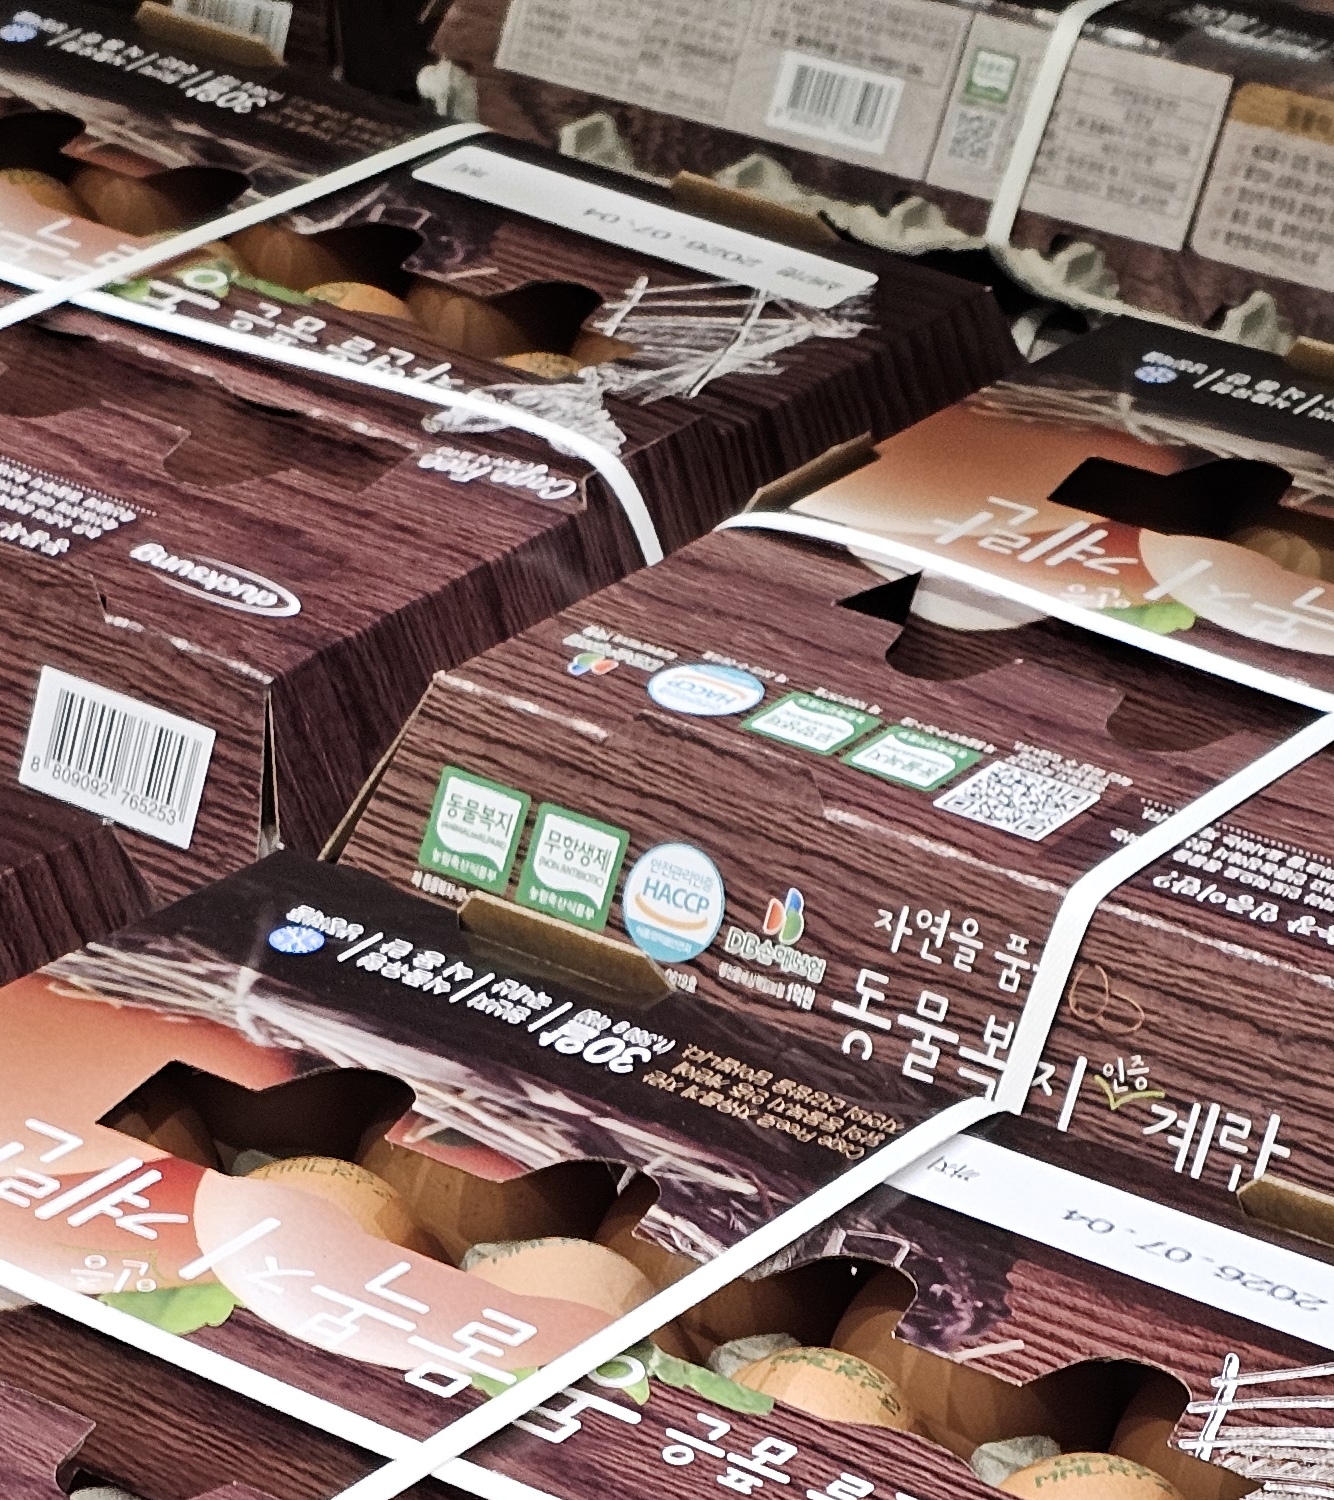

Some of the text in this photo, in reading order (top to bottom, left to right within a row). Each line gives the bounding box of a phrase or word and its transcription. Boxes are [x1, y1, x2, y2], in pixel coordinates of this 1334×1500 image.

[931, 496, 1141, 578] 계란
[52, 766, 110, 799] 809092
[120, 788, 178, 827] 765253
[446, 793, 513, 836] 동물복지
[544, 829, 611, 872] 무항생제
[642, 877, 709, 923] HACCP
[875, 906, 985, 974] 자연을
[539, 1019, 650, 1072] 30알
[1101, 1055, 1293, 1191] 인증 계란
[1061, 1206, 1116, 1236] 04
[664, 1411, 800, 1499] 품은
